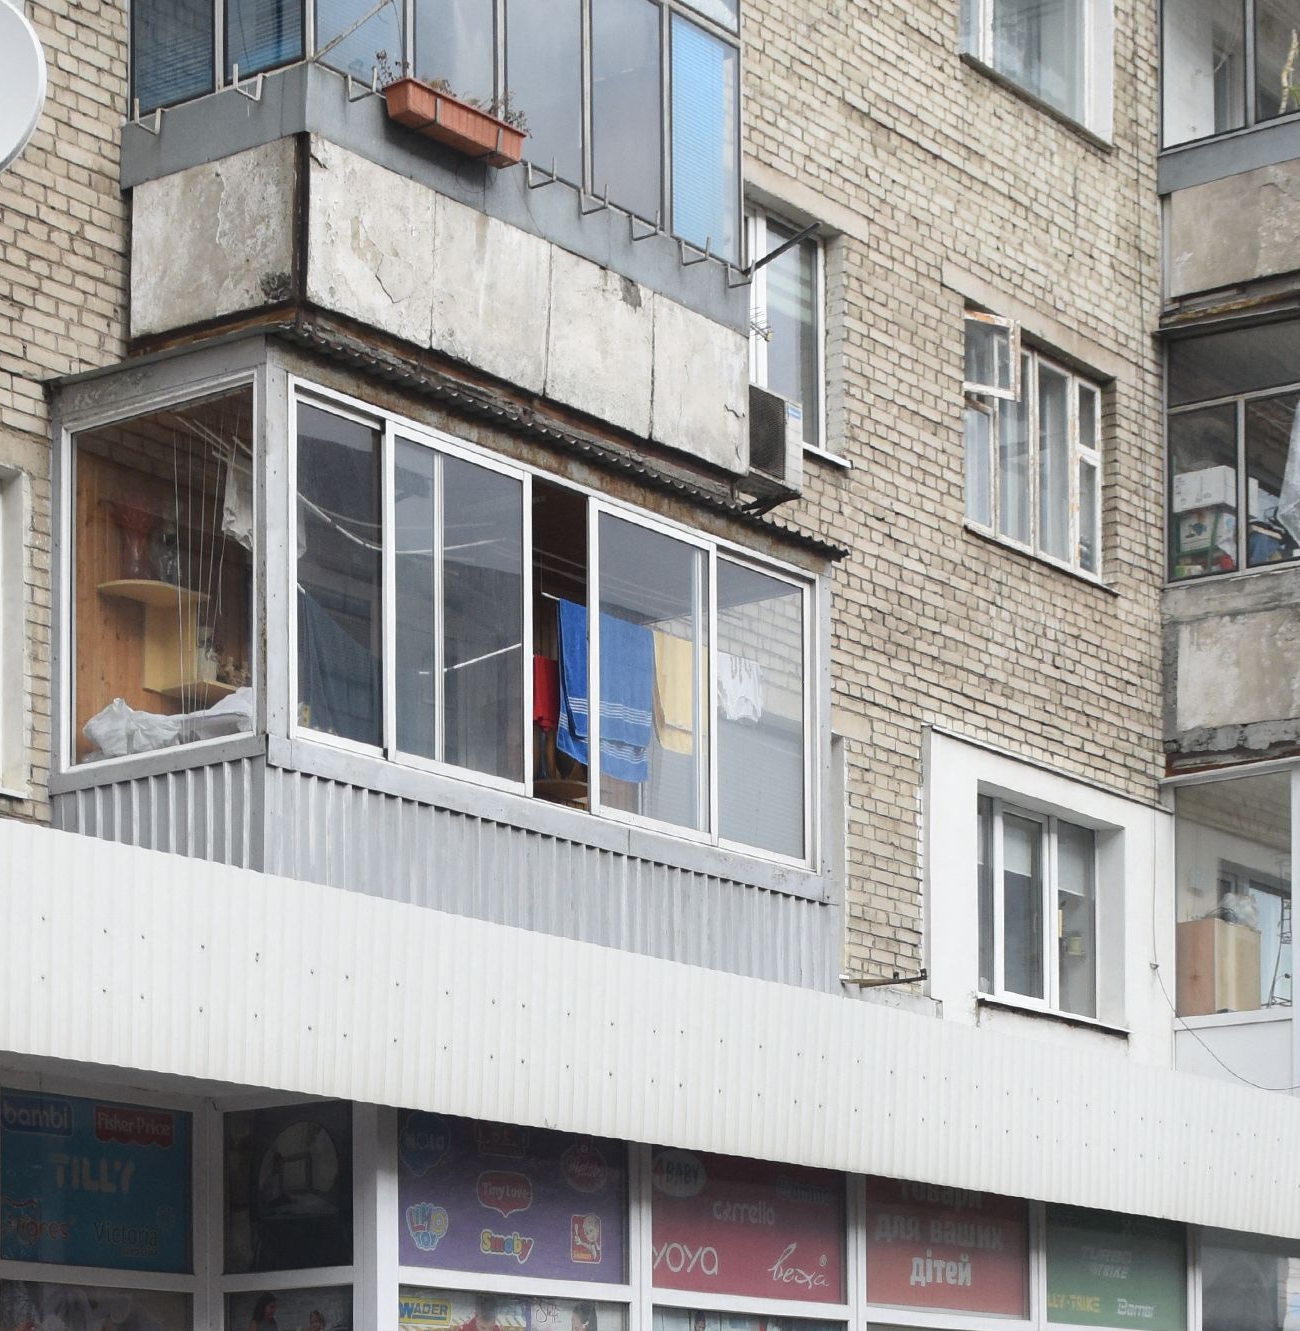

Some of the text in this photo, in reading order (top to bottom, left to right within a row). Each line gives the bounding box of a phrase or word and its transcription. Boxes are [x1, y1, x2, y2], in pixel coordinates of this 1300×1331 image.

[97, 1111, 171, 1137] Fisher-Price
[50, 1152, 136, 1195] TILLY
[875, 1213, 1005, 1250] для ваших
[909, 1247, 973, 1288] дітей
